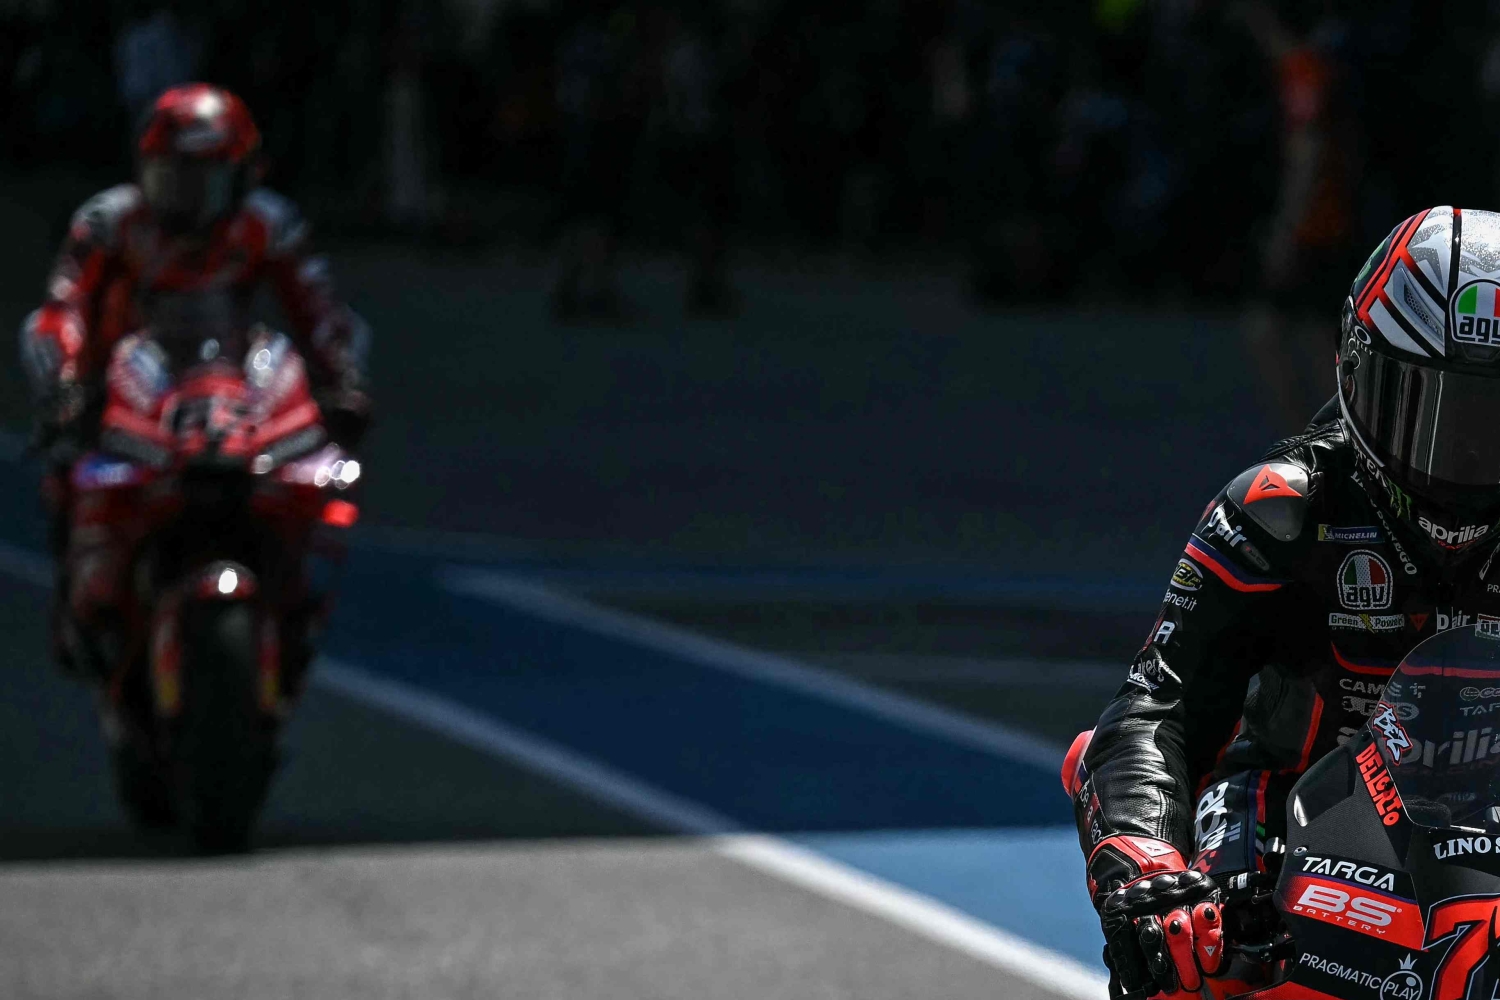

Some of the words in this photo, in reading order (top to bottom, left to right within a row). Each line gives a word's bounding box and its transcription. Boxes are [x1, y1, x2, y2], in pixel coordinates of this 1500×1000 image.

[1334, 531, 1378, 540] MICHELIN
[1418, 516, 1490, 544] aprilia
[1346, 586, 1385, 608] agv
[1331, 614, 1358, 626] Green
[1375, 616, 1403, 628] Power
[1433, 836, 1491, 860] LINO
[1301, 856, 1395, 892] TARGA
[1296, 884, 1397, 927] BS
[1292, 905, 1387, 935] BATTERY
[1299, 952, 1383, 990] PRAGMATIC
